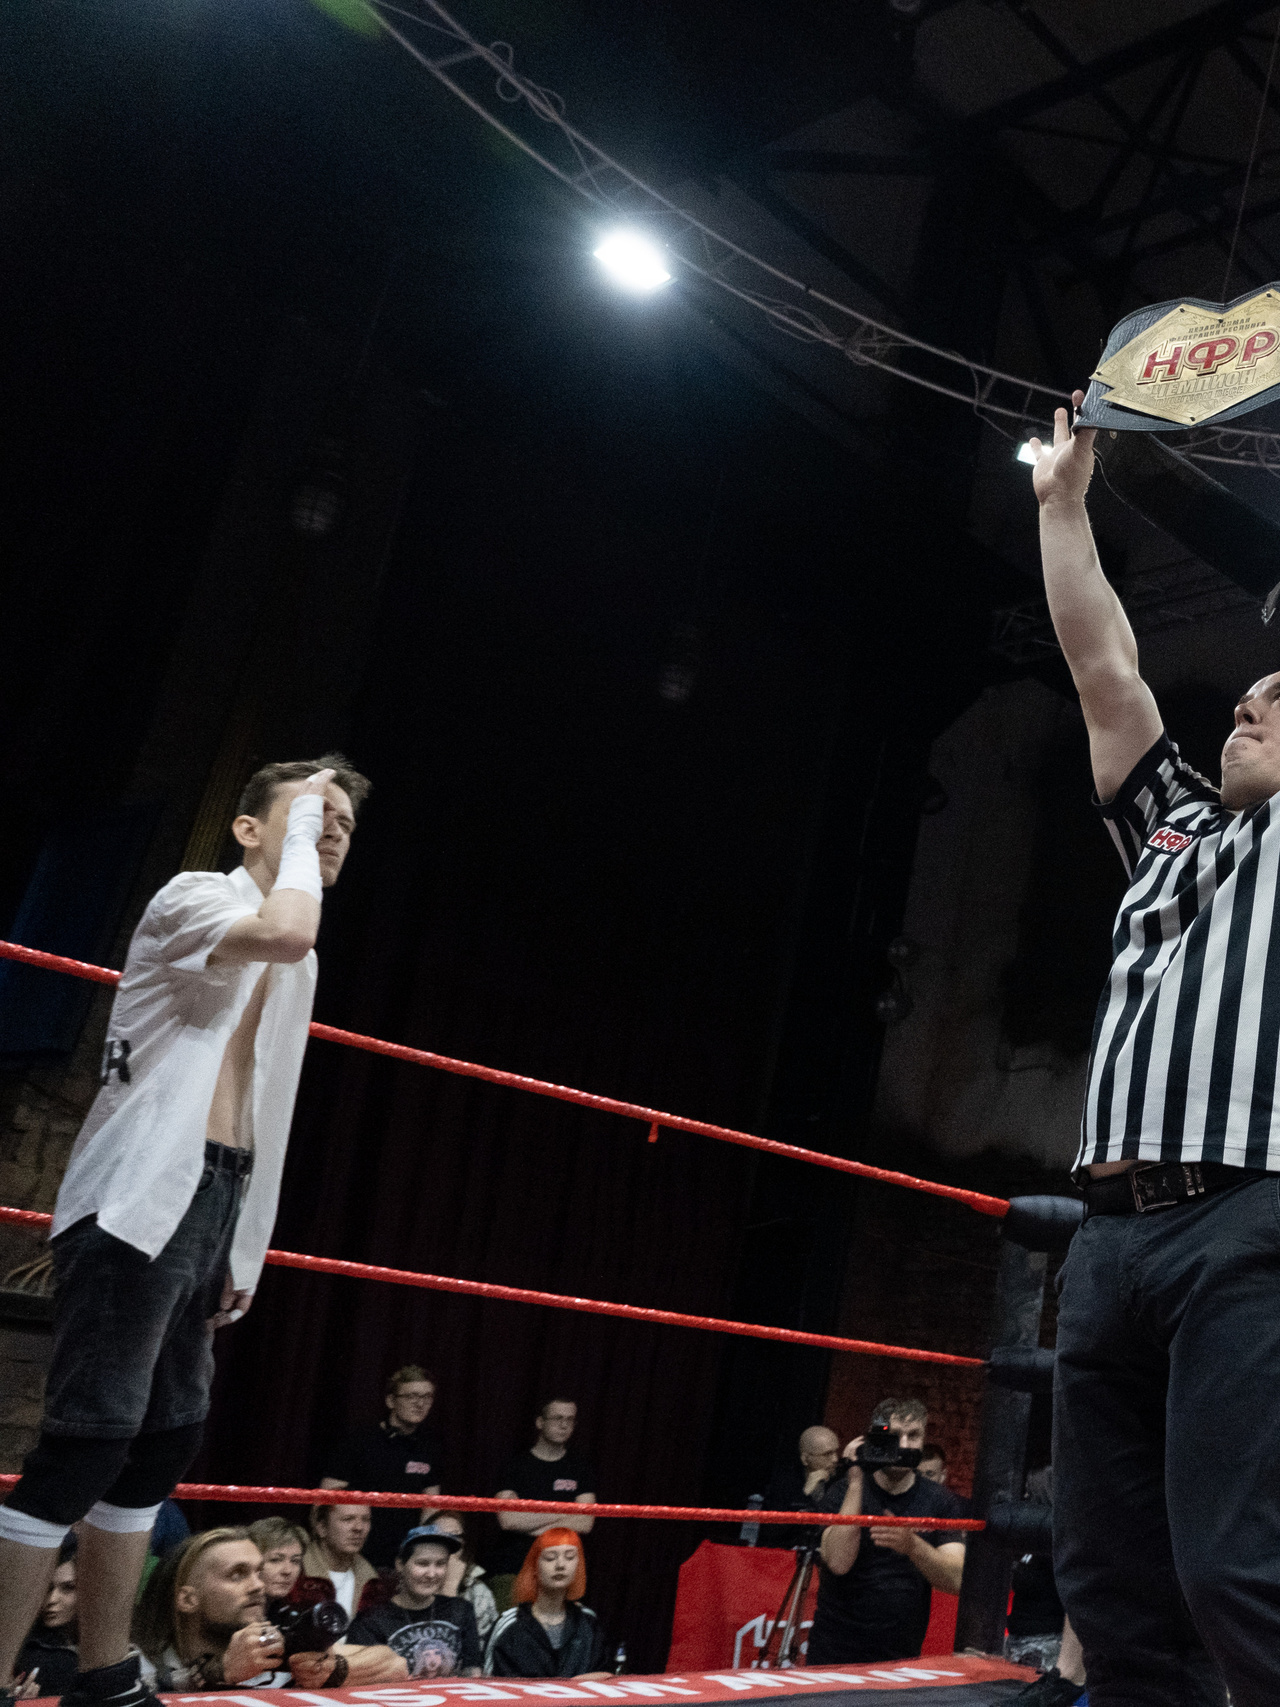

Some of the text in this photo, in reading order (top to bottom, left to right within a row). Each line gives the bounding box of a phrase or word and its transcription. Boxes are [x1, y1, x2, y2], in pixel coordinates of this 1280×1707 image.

[1169, 321, 1267, 343] ФЕДЕРАЦИЯ РЕСЛИНГА
[1188, 317, 1251, 333] НЕЗАВИСИМАЯ
[1137, 330, 1280, 384] НФР
[1151, 369, 1257, 398] ЧЕМПИОН
[1149, 827, 1192, 851] НФР
[161, 1667, 966, 1707] WWW.WRESTL
